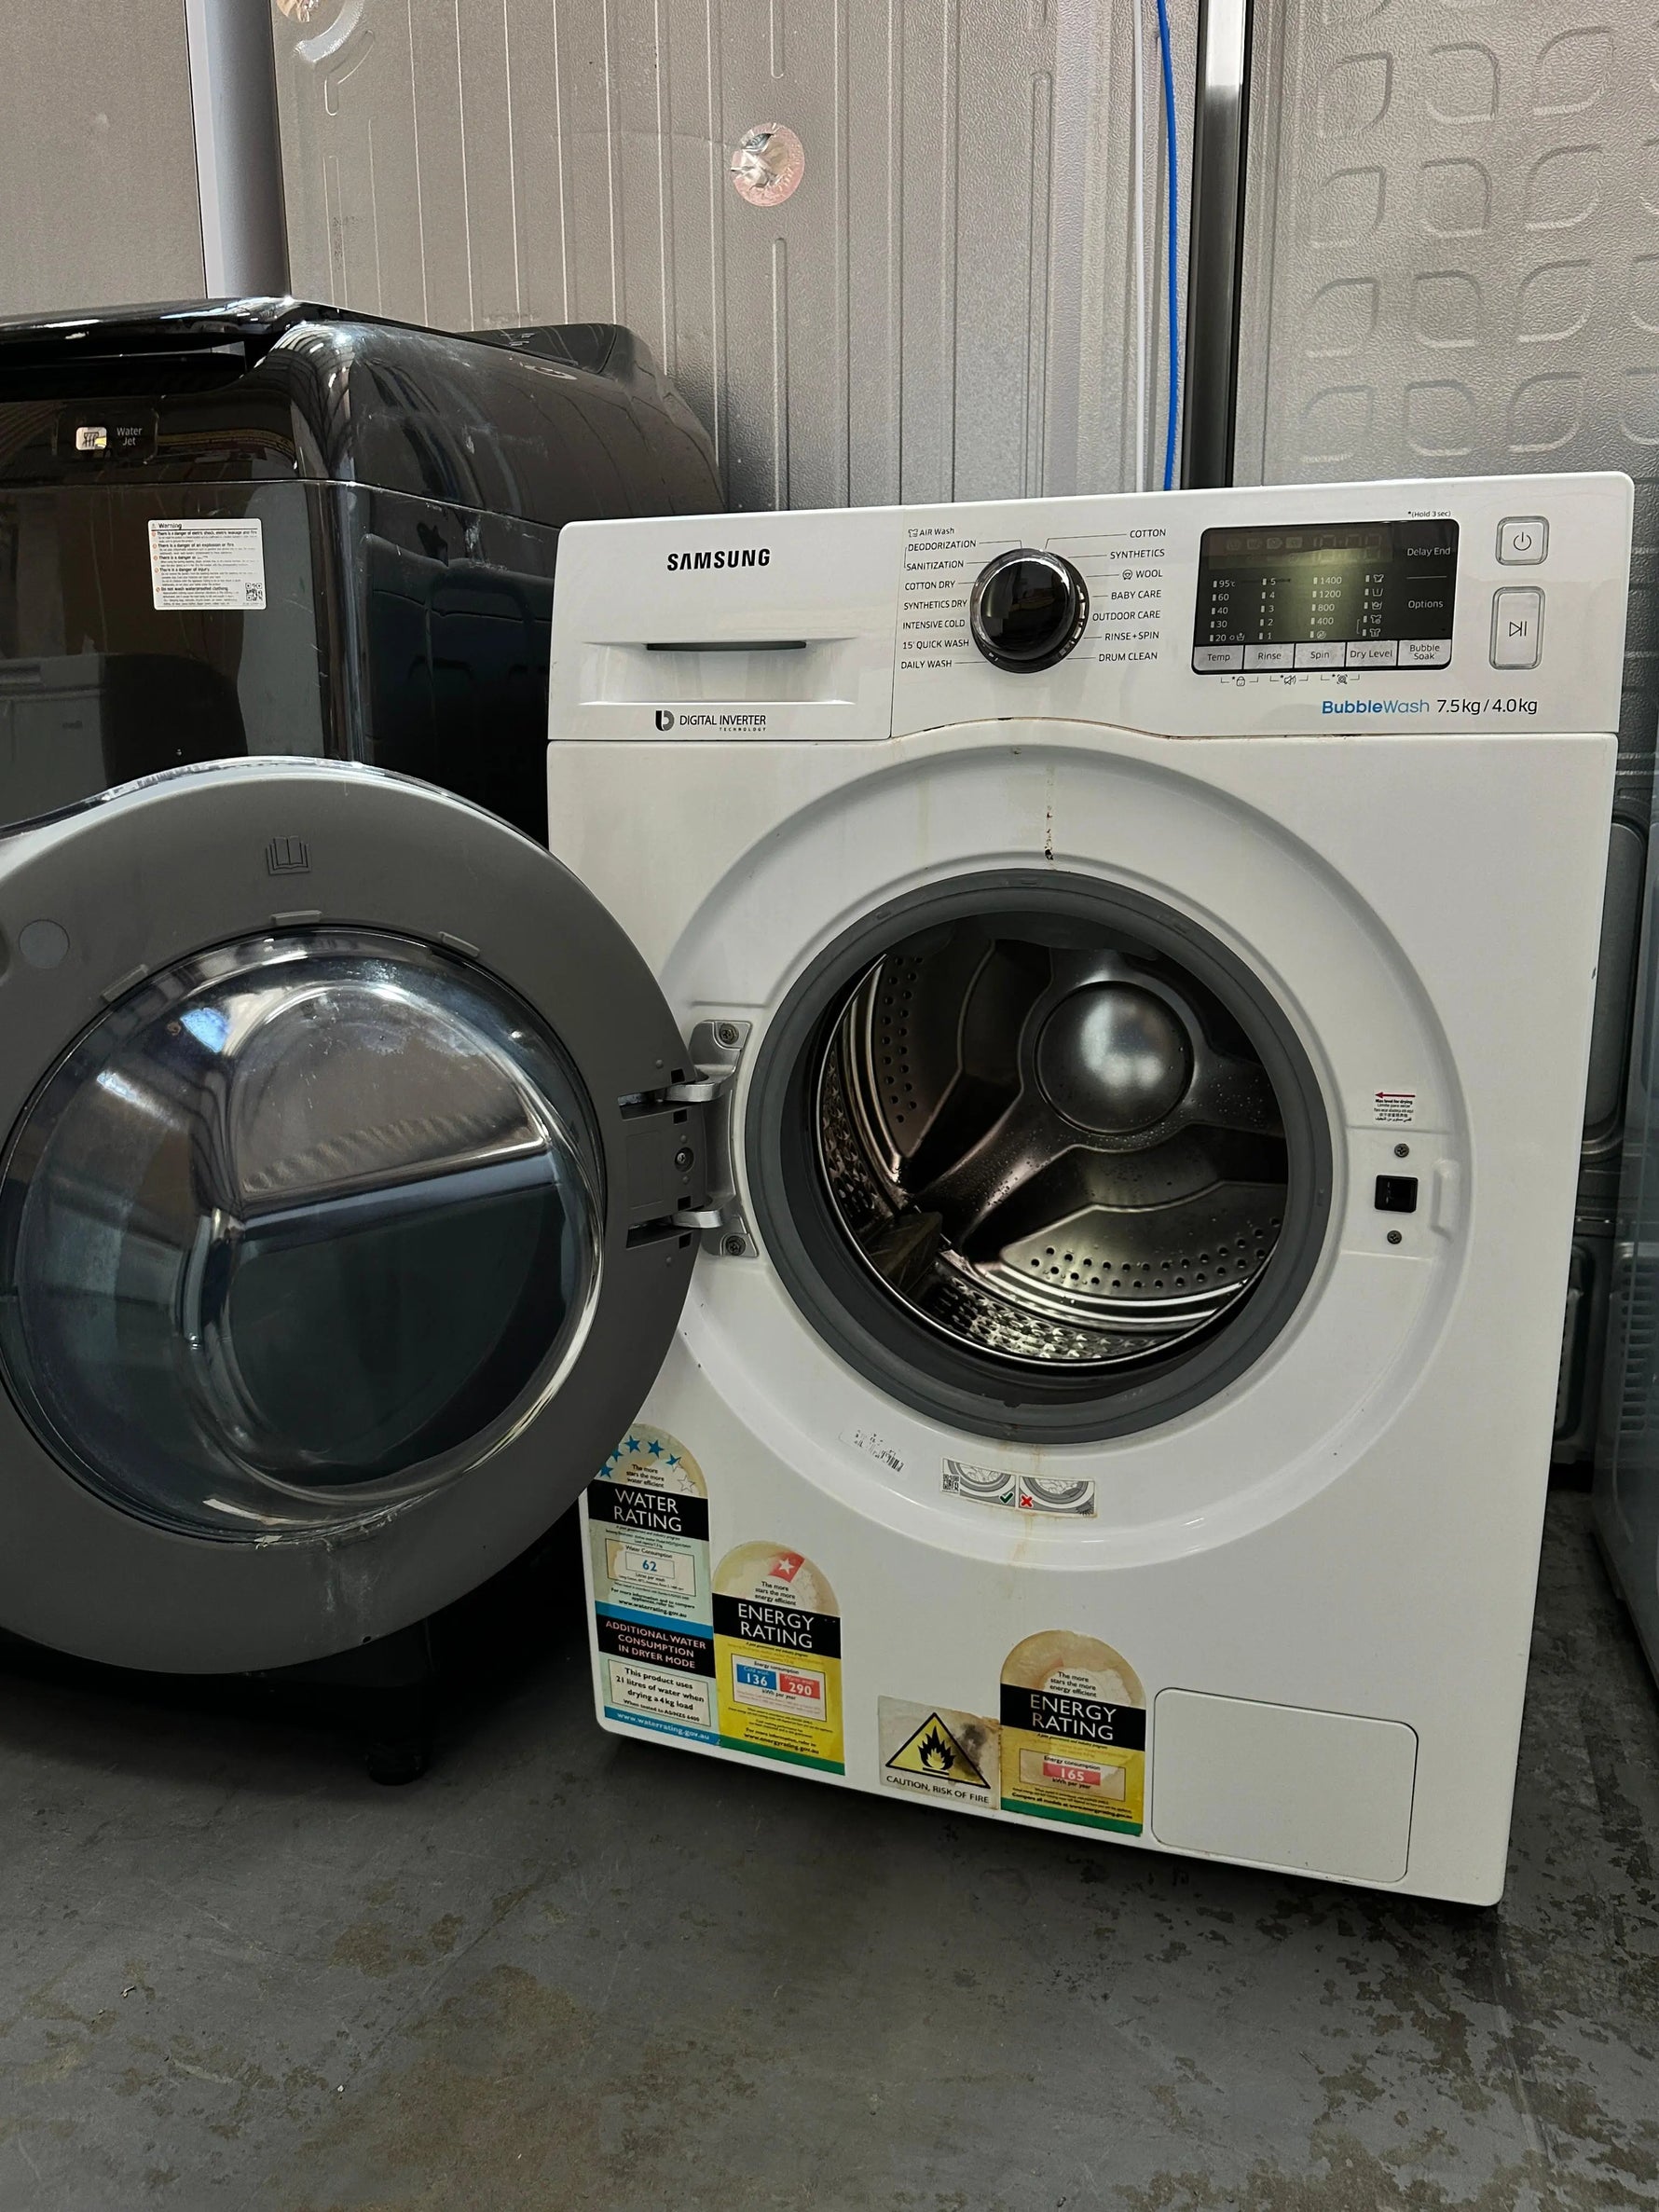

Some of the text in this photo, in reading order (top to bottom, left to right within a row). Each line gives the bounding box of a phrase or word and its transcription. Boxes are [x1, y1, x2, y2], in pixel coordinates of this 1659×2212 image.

[117, 428, 143, 436] Water
[123, 437, 136, 446] Jet
[935, 527, 954, 535] Wash
[1130, 529, 1166, 538] COTTON
[909, 540, 976, 552] DEODORIZATION
[1407, 546, 1451, 557] Delay End
[667, 548, 770, 571] SAMSUNG
[1110, 549, 1165, 559] SYNTHETICS
[907, 560, 964, 571] SANITIZATION
[1136, 570, 1163, 578] WOOL
[905, 581, 955, 591] COTTON DRY
[1111, 590, 1161, 599] BABY CARE
[1218, 593, 1229, 601] 60
[904, 599, 967, 611] SYNTHETICS DRY
[1408, 599, 1444, 609] Options
[1092, 611, 1160, 621] OUTDOOR CARE
[903, 619, 966, 629] INTENSIVE COLD
[1216, 620, 1227, 628] 30
[1215, 634, 1227, 642] 20
[916, 639, 942, 650] QUICK
[1409, 644, 1440, 653] Bubble
[1099, 652, 1158, 662] DRUM CLEAN
[1207, 653, 1230, 662] Temp
[1310, 651, 1330, 659] Spin
[1351, 650, 1392, 660] Dry Level
[901, 660, 952, 669] DAILY WASH
[1322, 699, 1430, 714] BubbleWash
[679, 715, 766, 725] DIGITAL INVERTER
[615, 1489, 679, 1514] WATER
[614, 1505, 681, 1532] RATING
[641, 1547, 672, 1559] Consumption
[642, 1559, 657, 1572] 62
[755, 1594, 796, 1605] energy efficient
[619, 1600, 687, 1618] www.waterrating.gov.au
[738, 1602, 815, 1631] ENERGY
[606, 1620, 706, 1649] ADDITIONAL WATER
[741, 1621, 812, 1648] RATING
[618, 1634, 694, 1657] CONSUMPTION
[619, 1644, 695, 1669] IN DRYER MODE
[754, 1660, 769, 1669] Energy
[771, 1665, 800, 1674] consumption
[624, 1667, 693, 1689] This product uses
[747, 1673, 768, 1686] 136
[626, 1679, 646, 1689] litres
[658, 1688, 680, 1697] water
[682, 1692, 705, 1702] when
[788, 1682, 812, 1696] 290
[1049, 1684, 1097, 1697] energy efficient
[627, 1689, 652, 1701] drying
[676, 1701, 693, 1711] load
[1030, 1694, 1117, 1723] ENERGY
[617, 1712, 709, 1740] www.waterrating.gov.au
[1033, 1711, 1113, 1740] RATING
[744, 1733, 819, 1754] www.energyrating.gov.au
[1044, 1755, 1101, 1770] Energy consumption
[1061, 1767, 1085, 1781] 165
[886, 1775, 989, 1804] CAUTION, RISK OF FIRE
